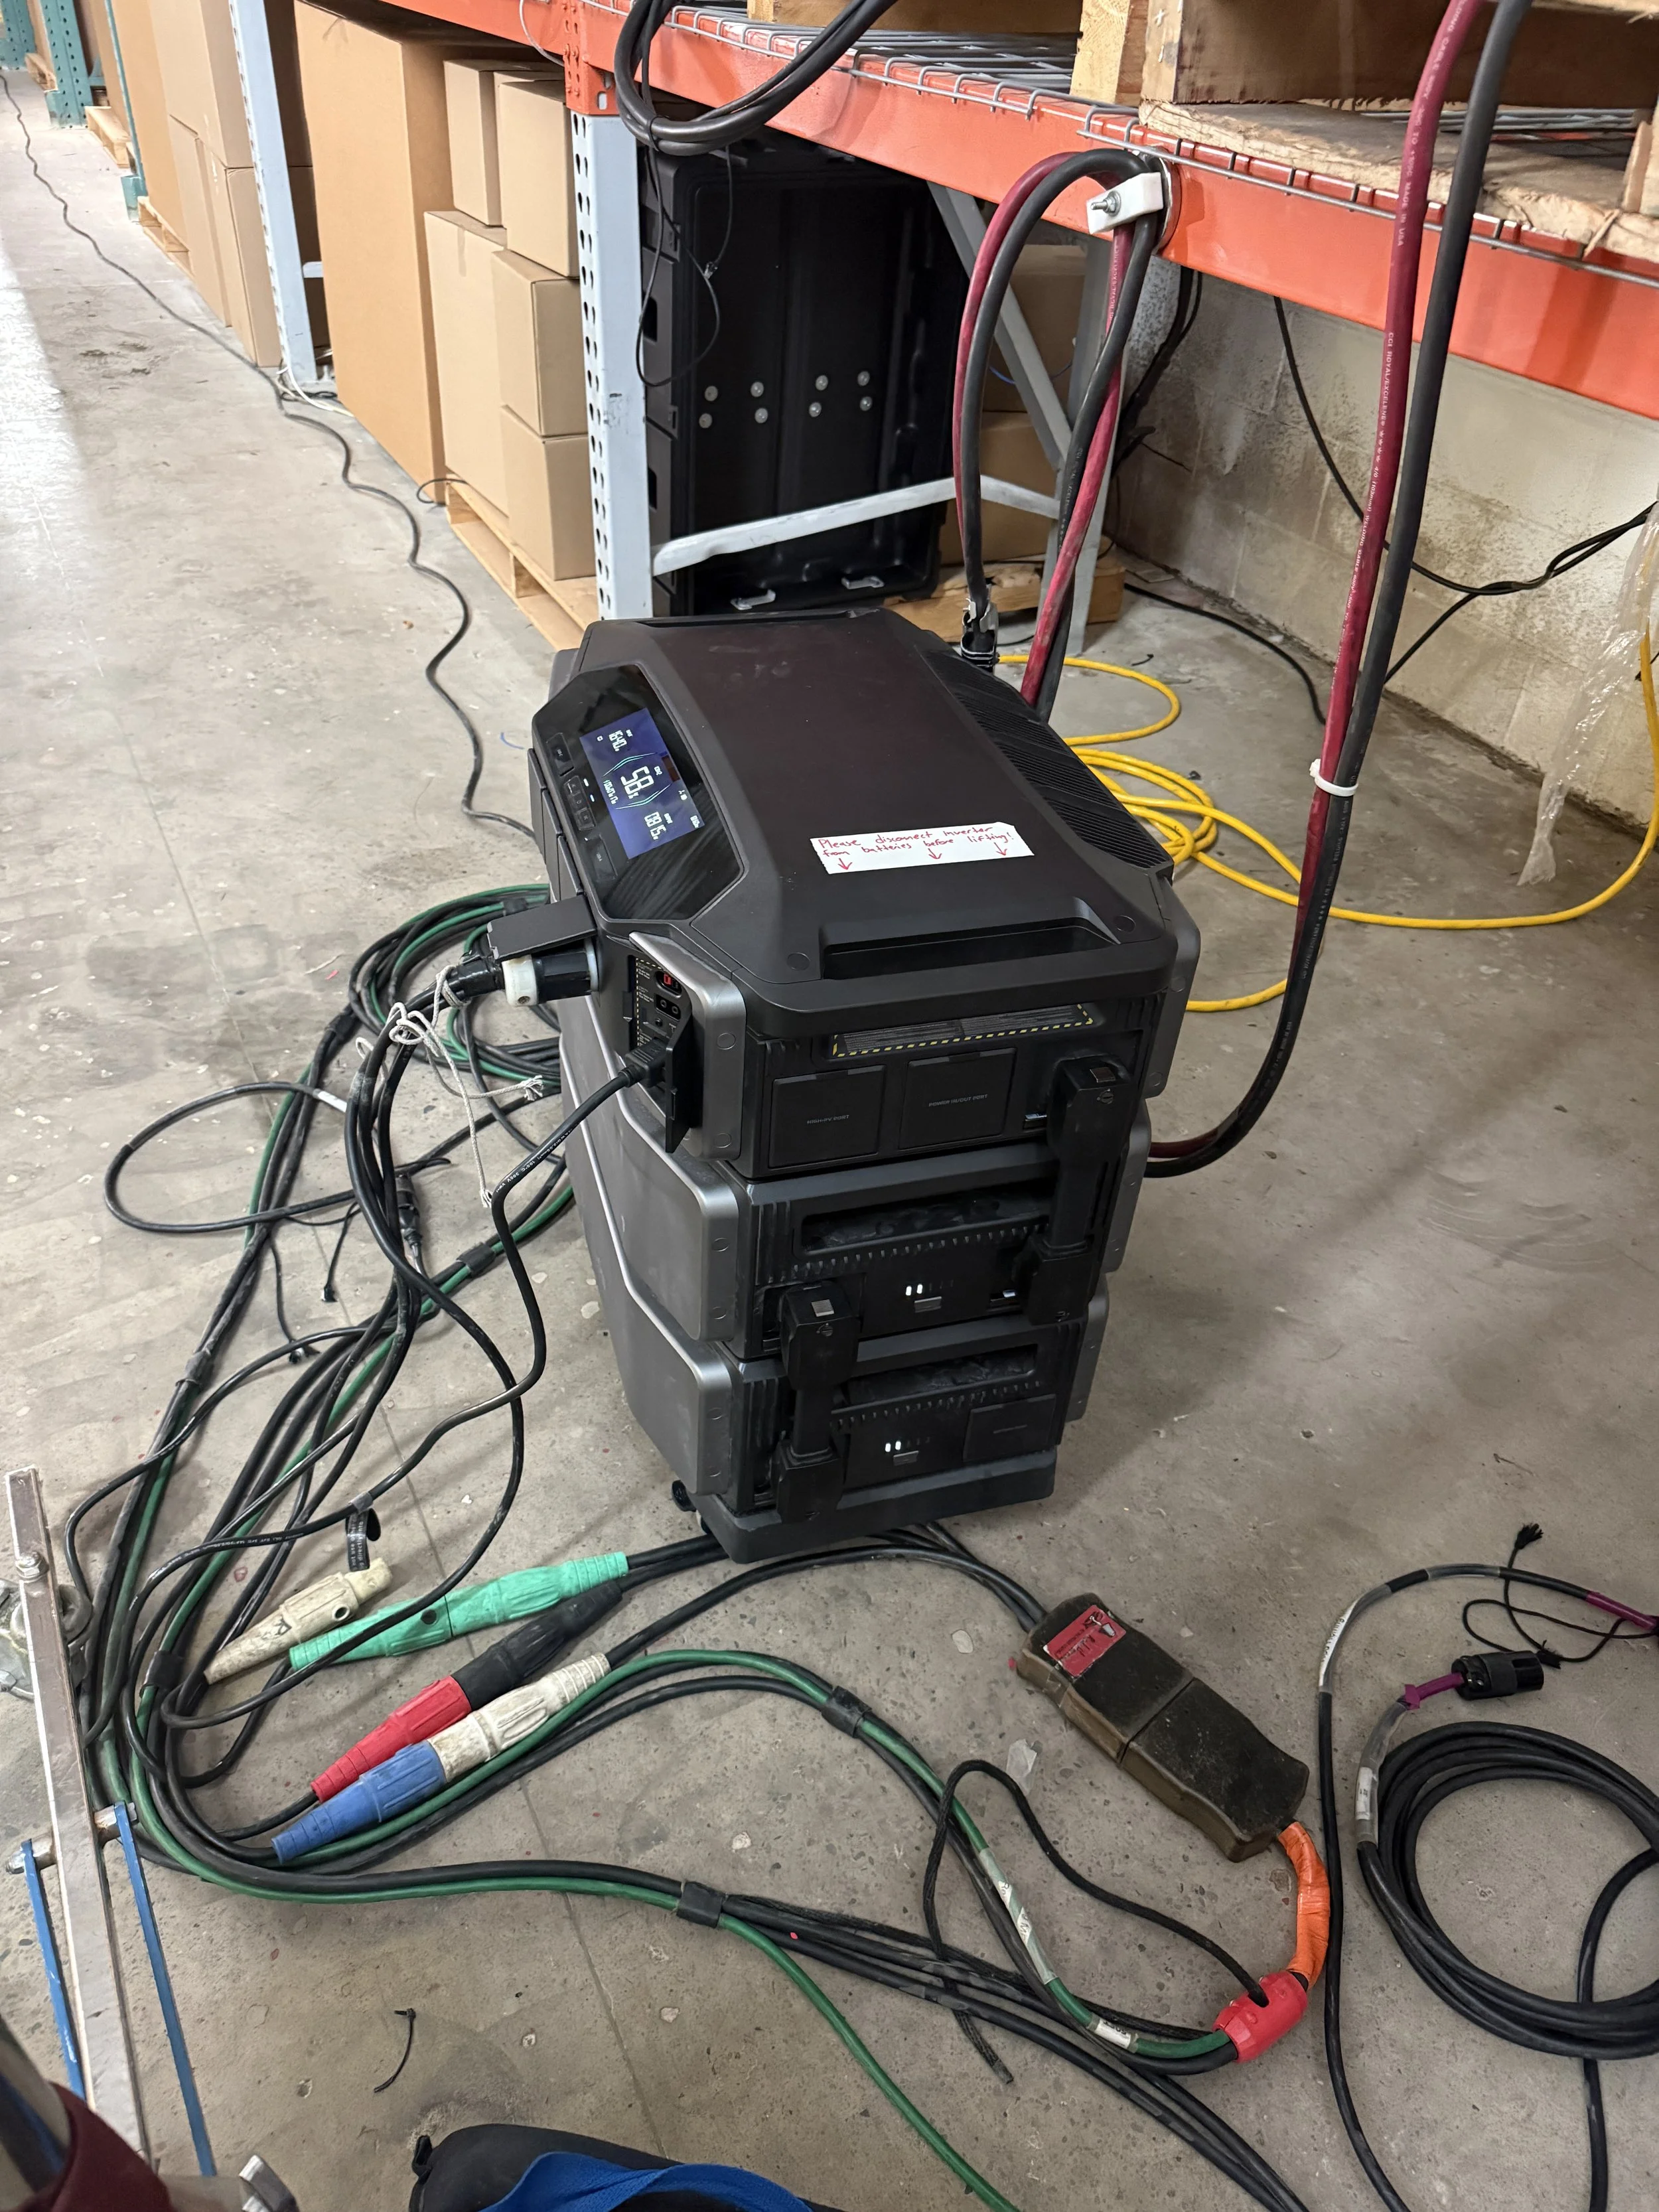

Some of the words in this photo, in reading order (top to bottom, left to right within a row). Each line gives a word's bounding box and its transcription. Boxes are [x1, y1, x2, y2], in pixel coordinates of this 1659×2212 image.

[1401, 213, 1407, 224] IN
[620, 765, 654, 799] 58%
[818, 838, 861, 849] Please
[942, 827, 994, 837] inverter
[861, 842, 912, 853] batteries
[922, 838, 954, 848] before
[967, 832, 1015, 844] lifting!
[506, 1172, 520, 1183] 300V
